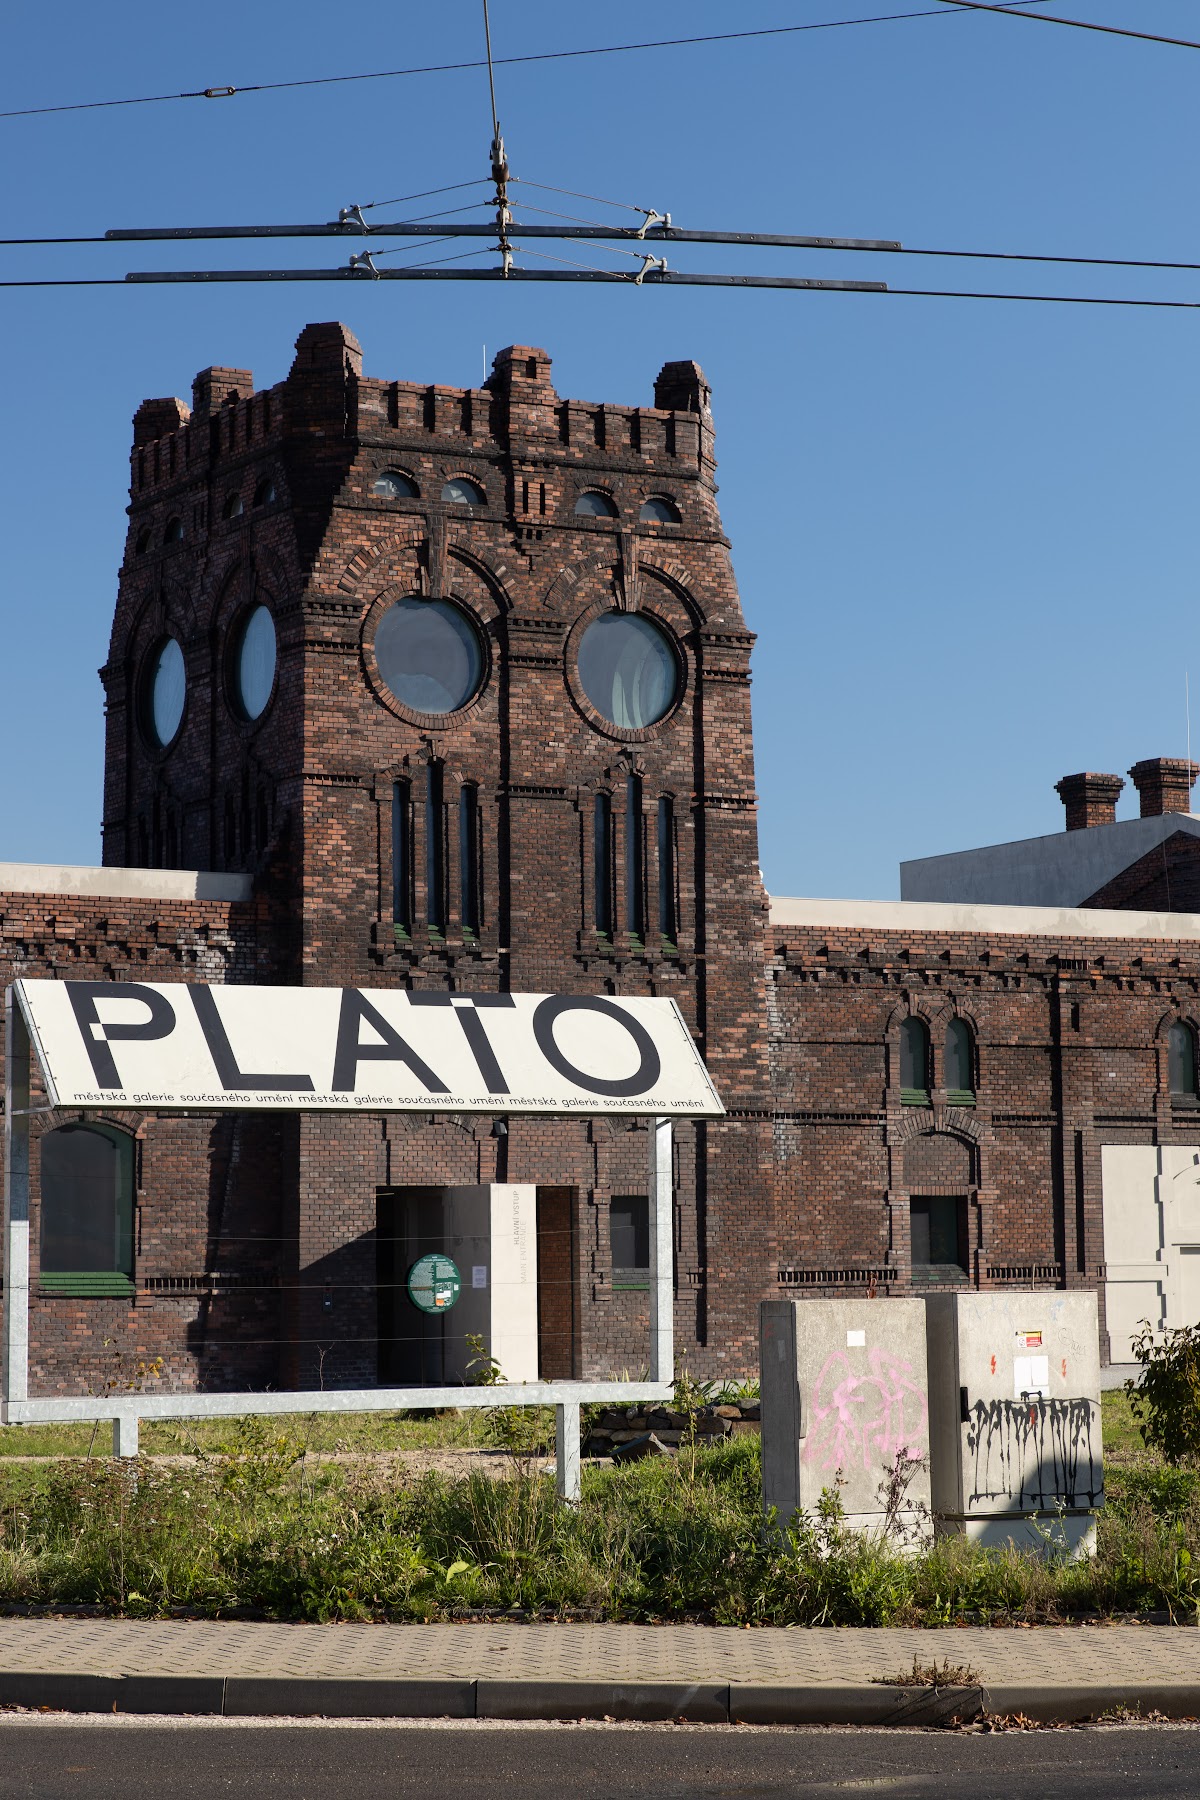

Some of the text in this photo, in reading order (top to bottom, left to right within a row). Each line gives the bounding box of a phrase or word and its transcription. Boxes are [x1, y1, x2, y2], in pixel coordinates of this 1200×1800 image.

[65, 981, 661, 1097] PLATO
[73, 1091, 706, 1108] městská galerie současného umění městská galerie současného umění městská galerie současného umění
